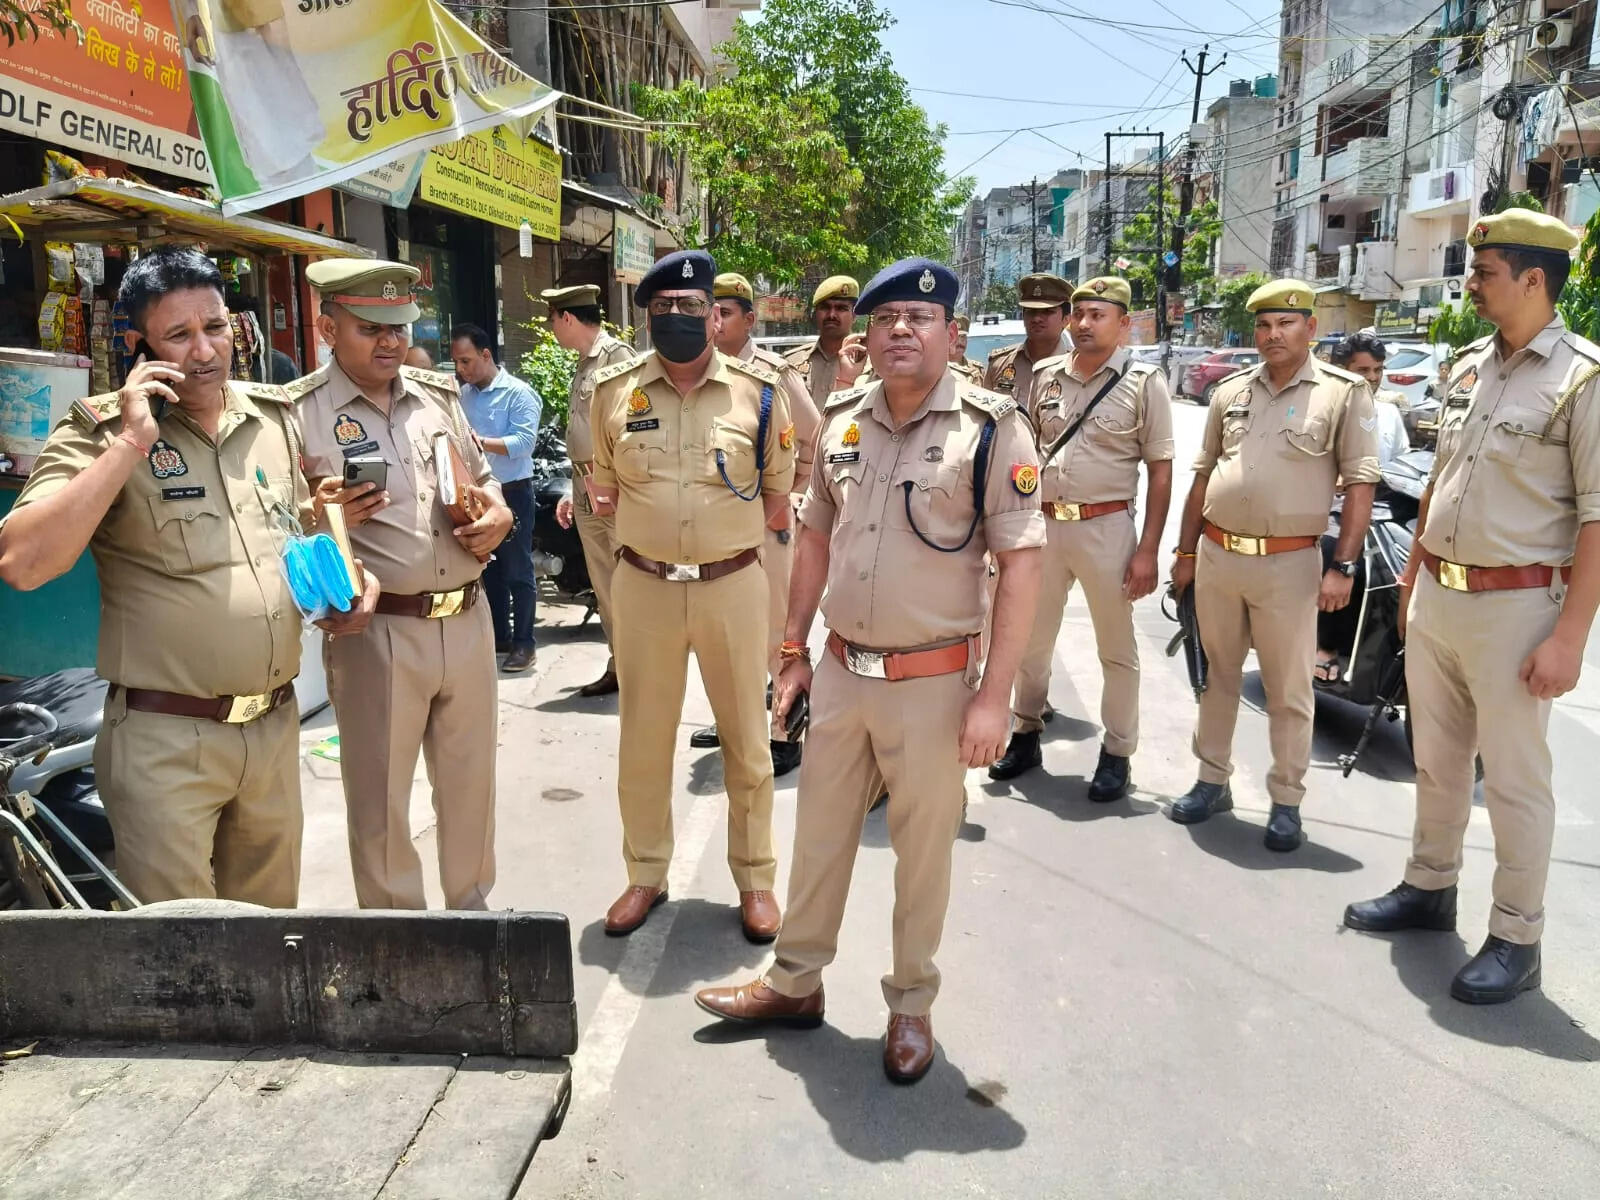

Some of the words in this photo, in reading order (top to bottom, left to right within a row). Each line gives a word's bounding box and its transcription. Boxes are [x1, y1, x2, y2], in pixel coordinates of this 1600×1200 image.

[86, 26, 121, 68] लिख
[125, 41, 140, 75] के
[143, 50, 157, 81] ले
[143, 21, 160, 45] का
[162, 31, 181, 59] वाद
[0, 87, 52, 128] DLF
[60, 109, 167, 162] GENERAL
[172, 142, 209, 174] STO
[429, 185, 449, 201] Branch
[436, 160, 472, 186] Construction
[492, 146, 559, 203] BUILDERS
